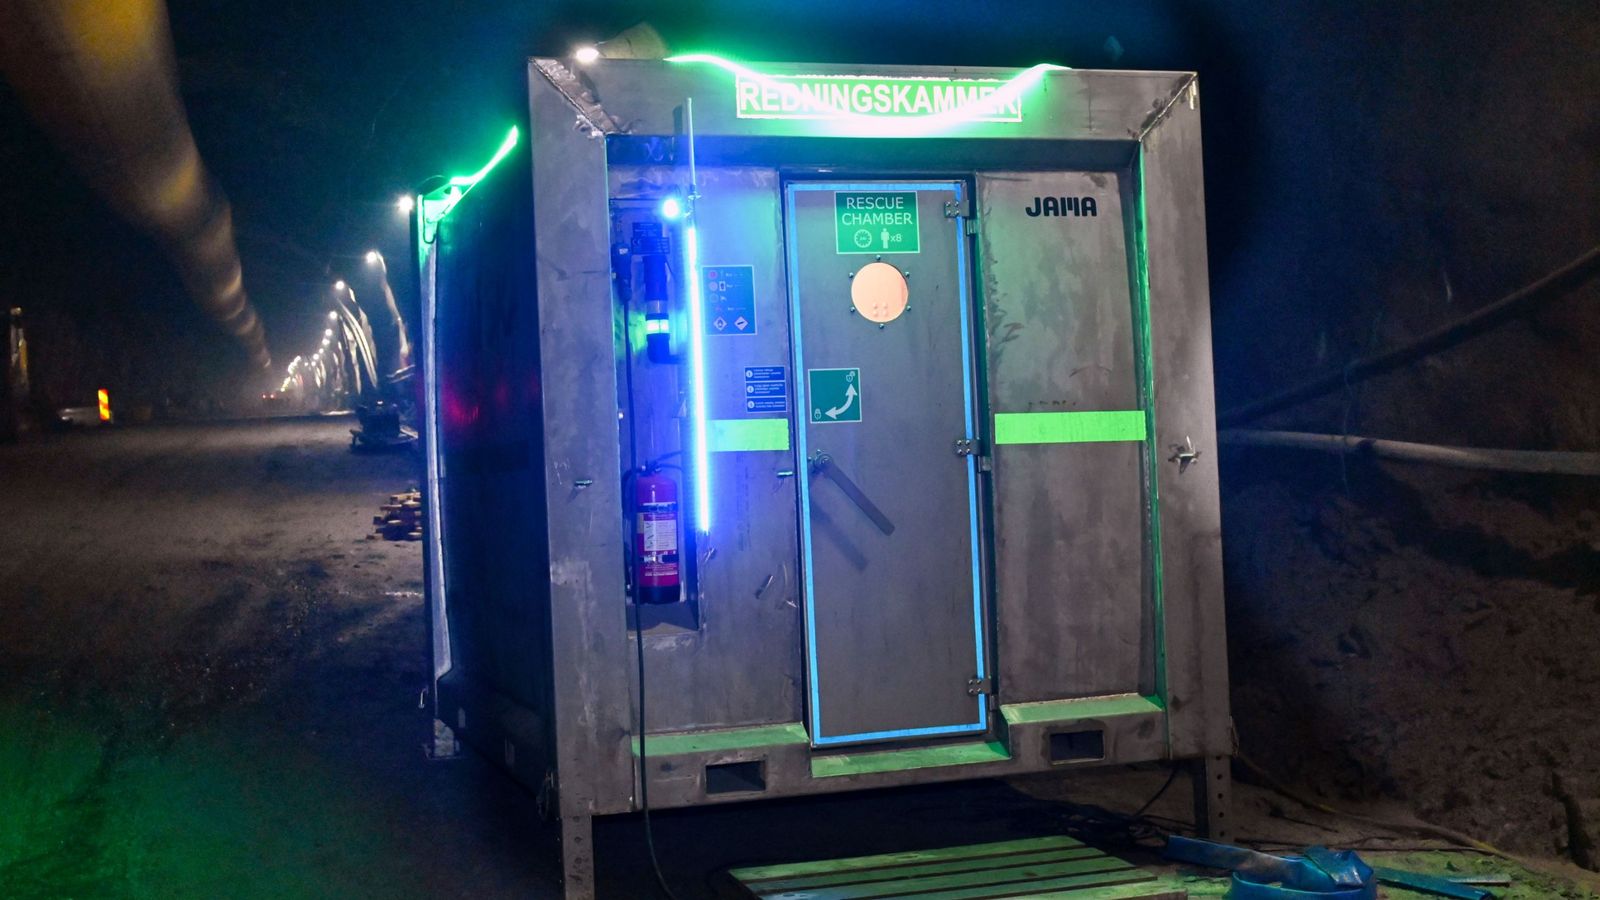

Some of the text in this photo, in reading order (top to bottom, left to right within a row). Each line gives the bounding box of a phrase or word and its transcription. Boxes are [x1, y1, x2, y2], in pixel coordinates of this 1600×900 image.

[846, 196, 904, 210] RESCUE
[1025, 196, 1097, 217] JAMA
[841, 212, 913, 226] CHAMBER
